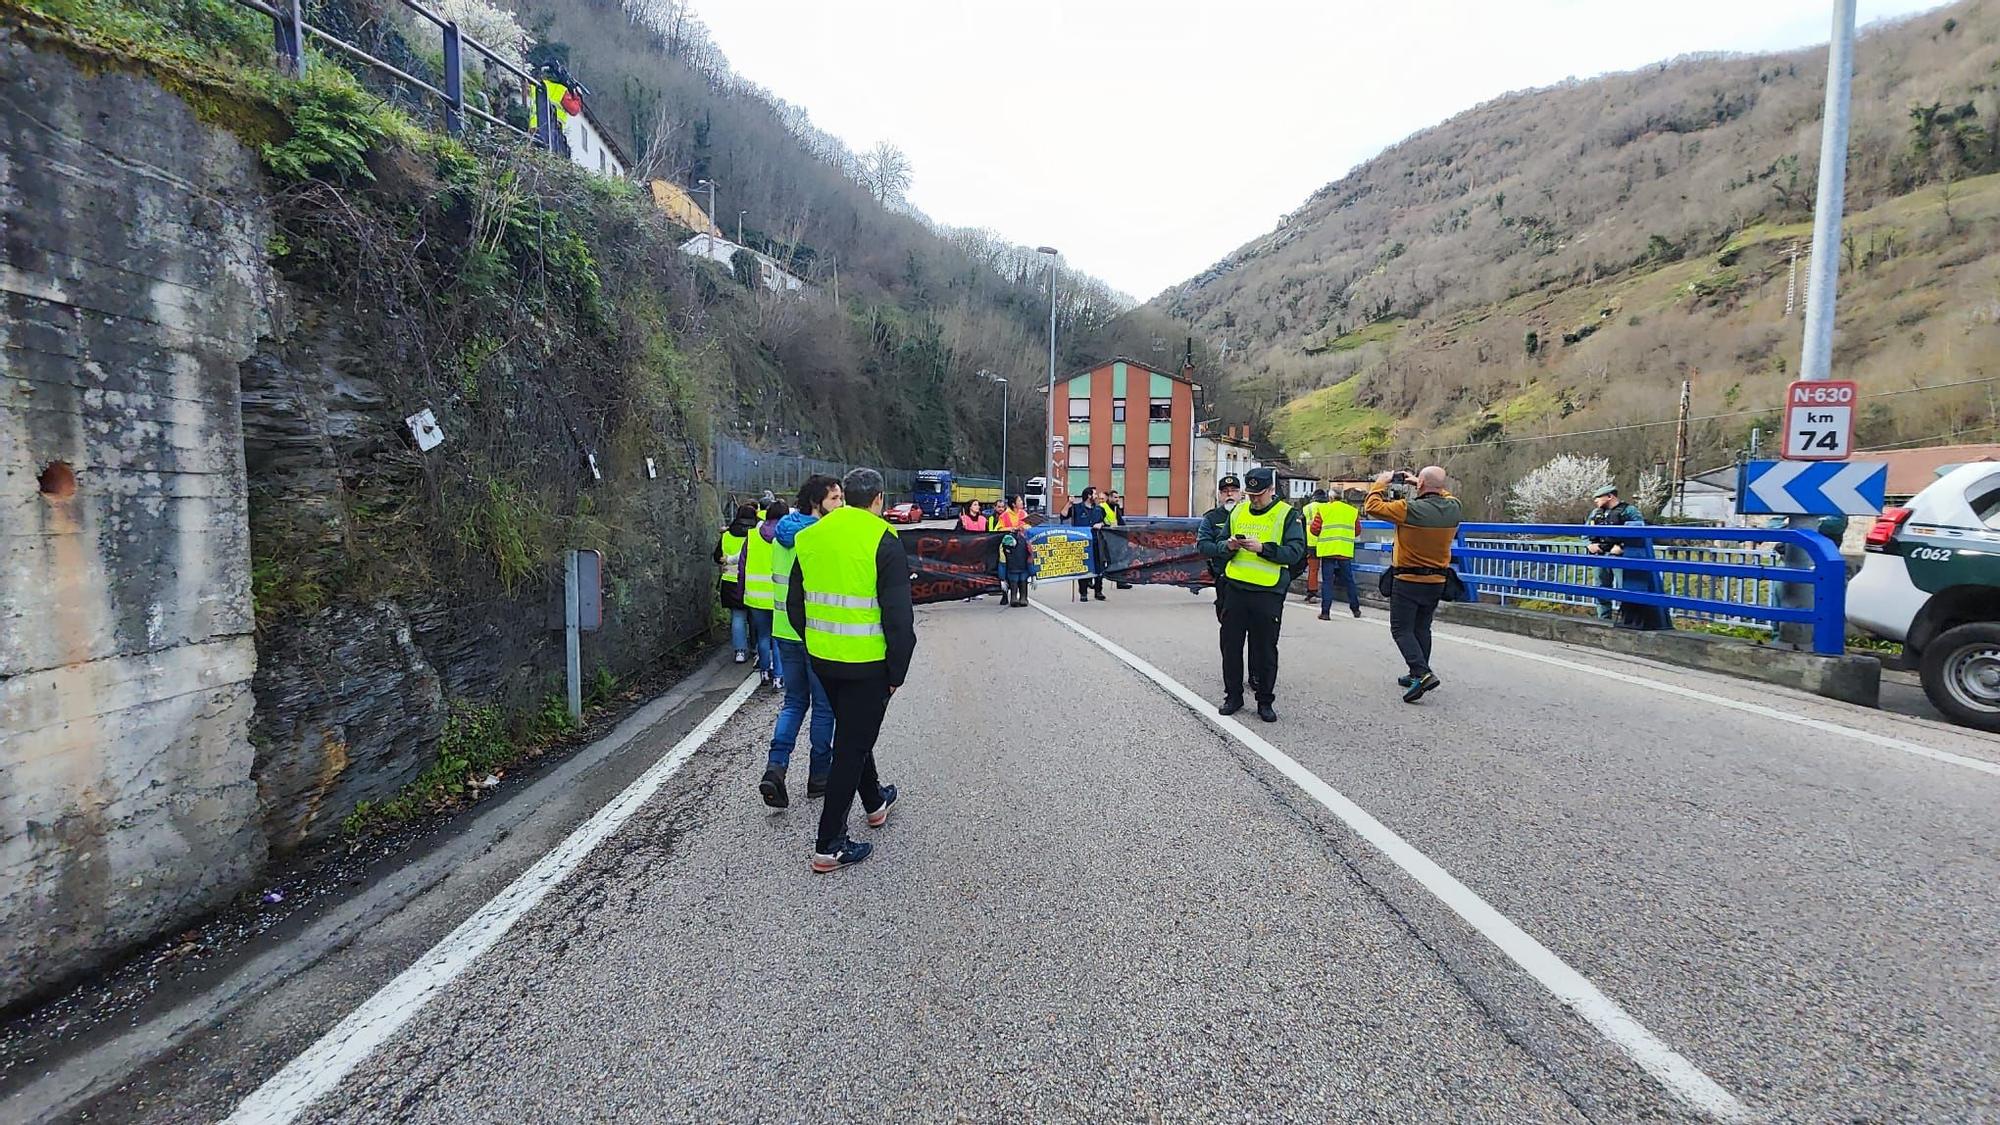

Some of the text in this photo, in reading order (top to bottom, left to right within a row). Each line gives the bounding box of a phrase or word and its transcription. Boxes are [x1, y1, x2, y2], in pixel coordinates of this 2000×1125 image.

[1794, 387, 1852, 403] N-630
[1807, 412, 1834, 423] km
[1799, 430, 1839, 451] 74
[1921, 548, 1952, 561] 062
